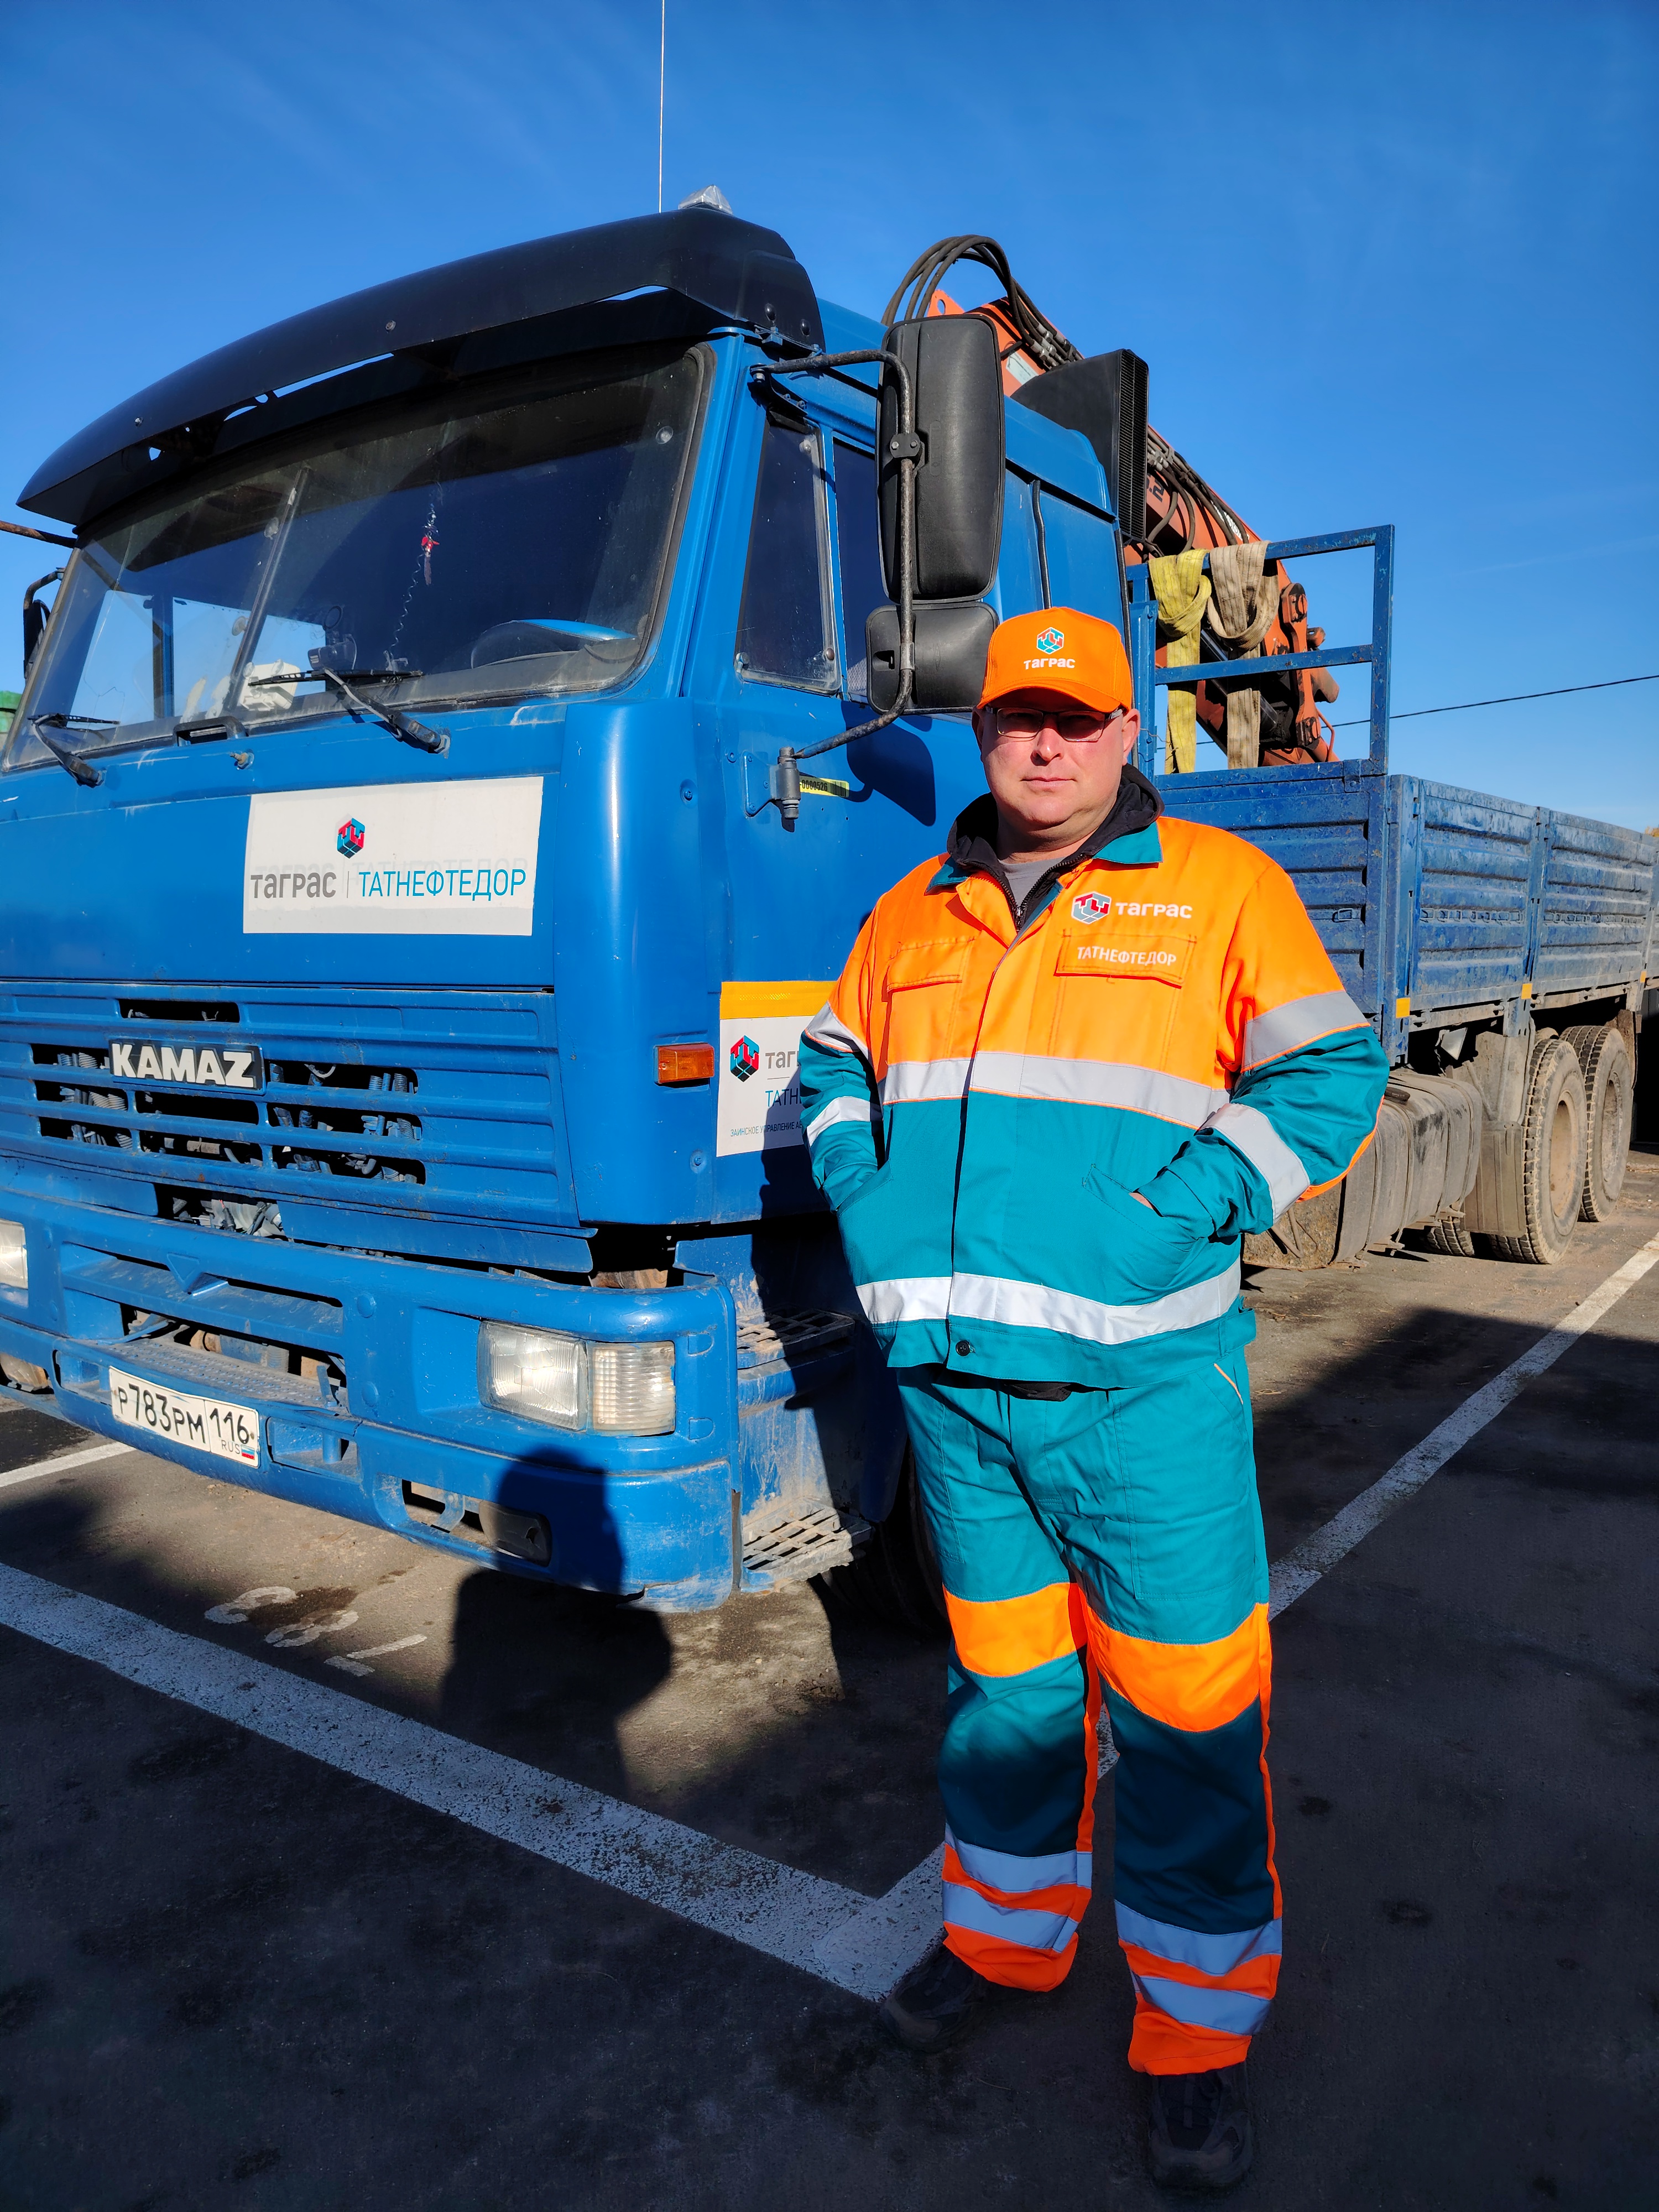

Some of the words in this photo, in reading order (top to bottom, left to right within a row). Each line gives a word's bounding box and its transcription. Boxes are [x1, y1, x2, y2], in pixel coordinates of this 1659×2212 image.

[358, 869, 526, 901] ТАТНЕФТЕДОР
[1077, 946, 1177, 966] ТАТНЕФТЕДОР
[112, 1043, 254, 1088] KAMAZ
[765, 1088, 802, 1107] ТАТН
[731, 1125, 759, 1137] ЗАИНСКОЕ
[760, 1121, 795, 1134] УПРАВЛЕНИЕ
[210, 1407, 249, 1444] 116
[221, 1439, 241, 1455] RUS
